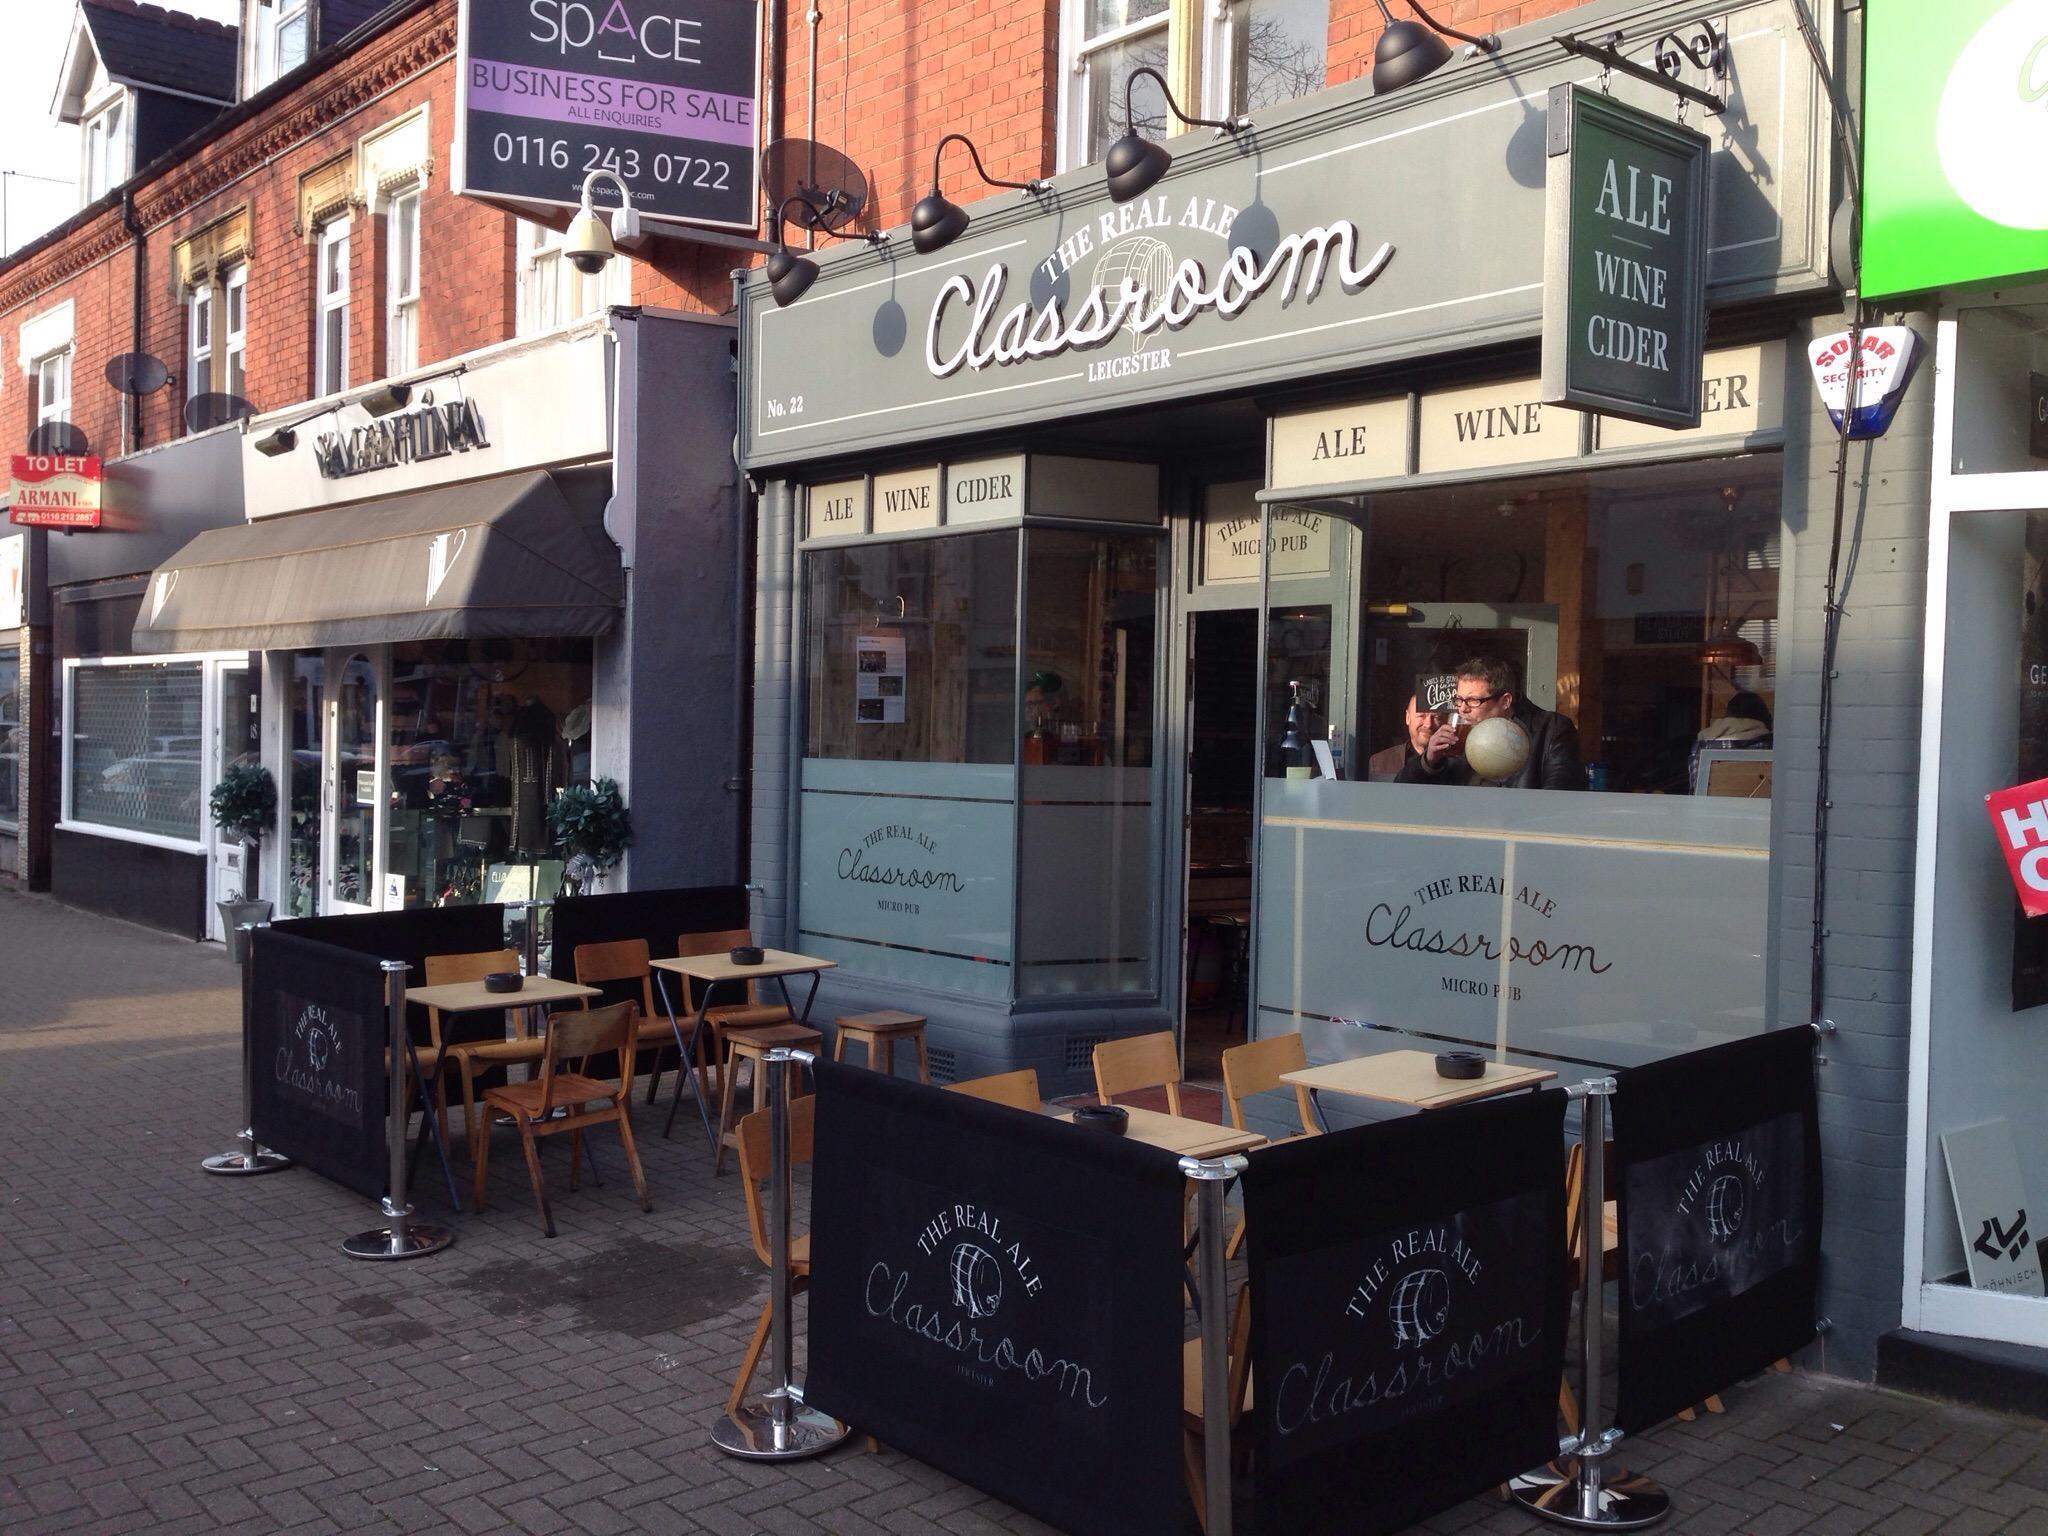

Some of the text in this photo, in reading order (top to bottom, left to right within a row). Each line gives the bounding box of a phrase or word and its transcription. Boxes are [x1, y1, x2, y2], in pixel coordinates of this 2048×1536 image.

[473, 64, 750, 125] BUSINESS FOR SALE
[568, 106, 662, 129] ALL ENQUIRIES
[494, 133, 730, 190] 0116 243 0722
[1595, 158, 1672, 235] ALE
[1041, 195, 1239, 285] THE REAL ALE
[926, 218, 1395, 380] Classroom
[1595, 250, 1667, 309] WINE
[1588, 315, 1669, 372] CIDER
[1816, 335, 1896, 368] SOAR
[1088, 349, 1172, 383] LEICESTER
[1823, 367, 1887, 384] SECRITY
[768, 396, 804, 419] No. 22
[1454, 402, 1541, 442] WINE
[1312, 426, 1366, 460] ALE
[26, 456, 87, 472] TO LET
[18, 489, 77, 506] ARMANI
[885, 485, 930, 513] WINE
[956, 474, 1013, 504] CIDER
[824, 497, 853, 522] ALE
[1217, 512, 1247, 543] THE
[1292, 510, 1322, 533] ALE
[1281, 534, 1307, 552] PUB
[863, 824, 938, 855] THE REAL ALE
[838, 848, 964, 892] Classroom
[878, 900, 920, 915] MICRO PUB
[1414, 878, 1453, 905] THE
[1515, 886, 1557, 918] ALE
[1366, 903, 1612, 974] Classroom
[1441, 977, 1488, 997] MICRO
[295, 1005, 343, 1054] THE REAL ALE
[276, 1047, 362, 1113] Classroom
[1677, 1141, 1767, 1216] THE REAL ALE
[917, 1204, 1043, 1298] THE REAL ALE
[1346, 1228, 1482, 1319] THE REAL ALE
[866, 1261, 1108, 1407] Classroom
[1276, 1317, 1541, 1435] Classroom
